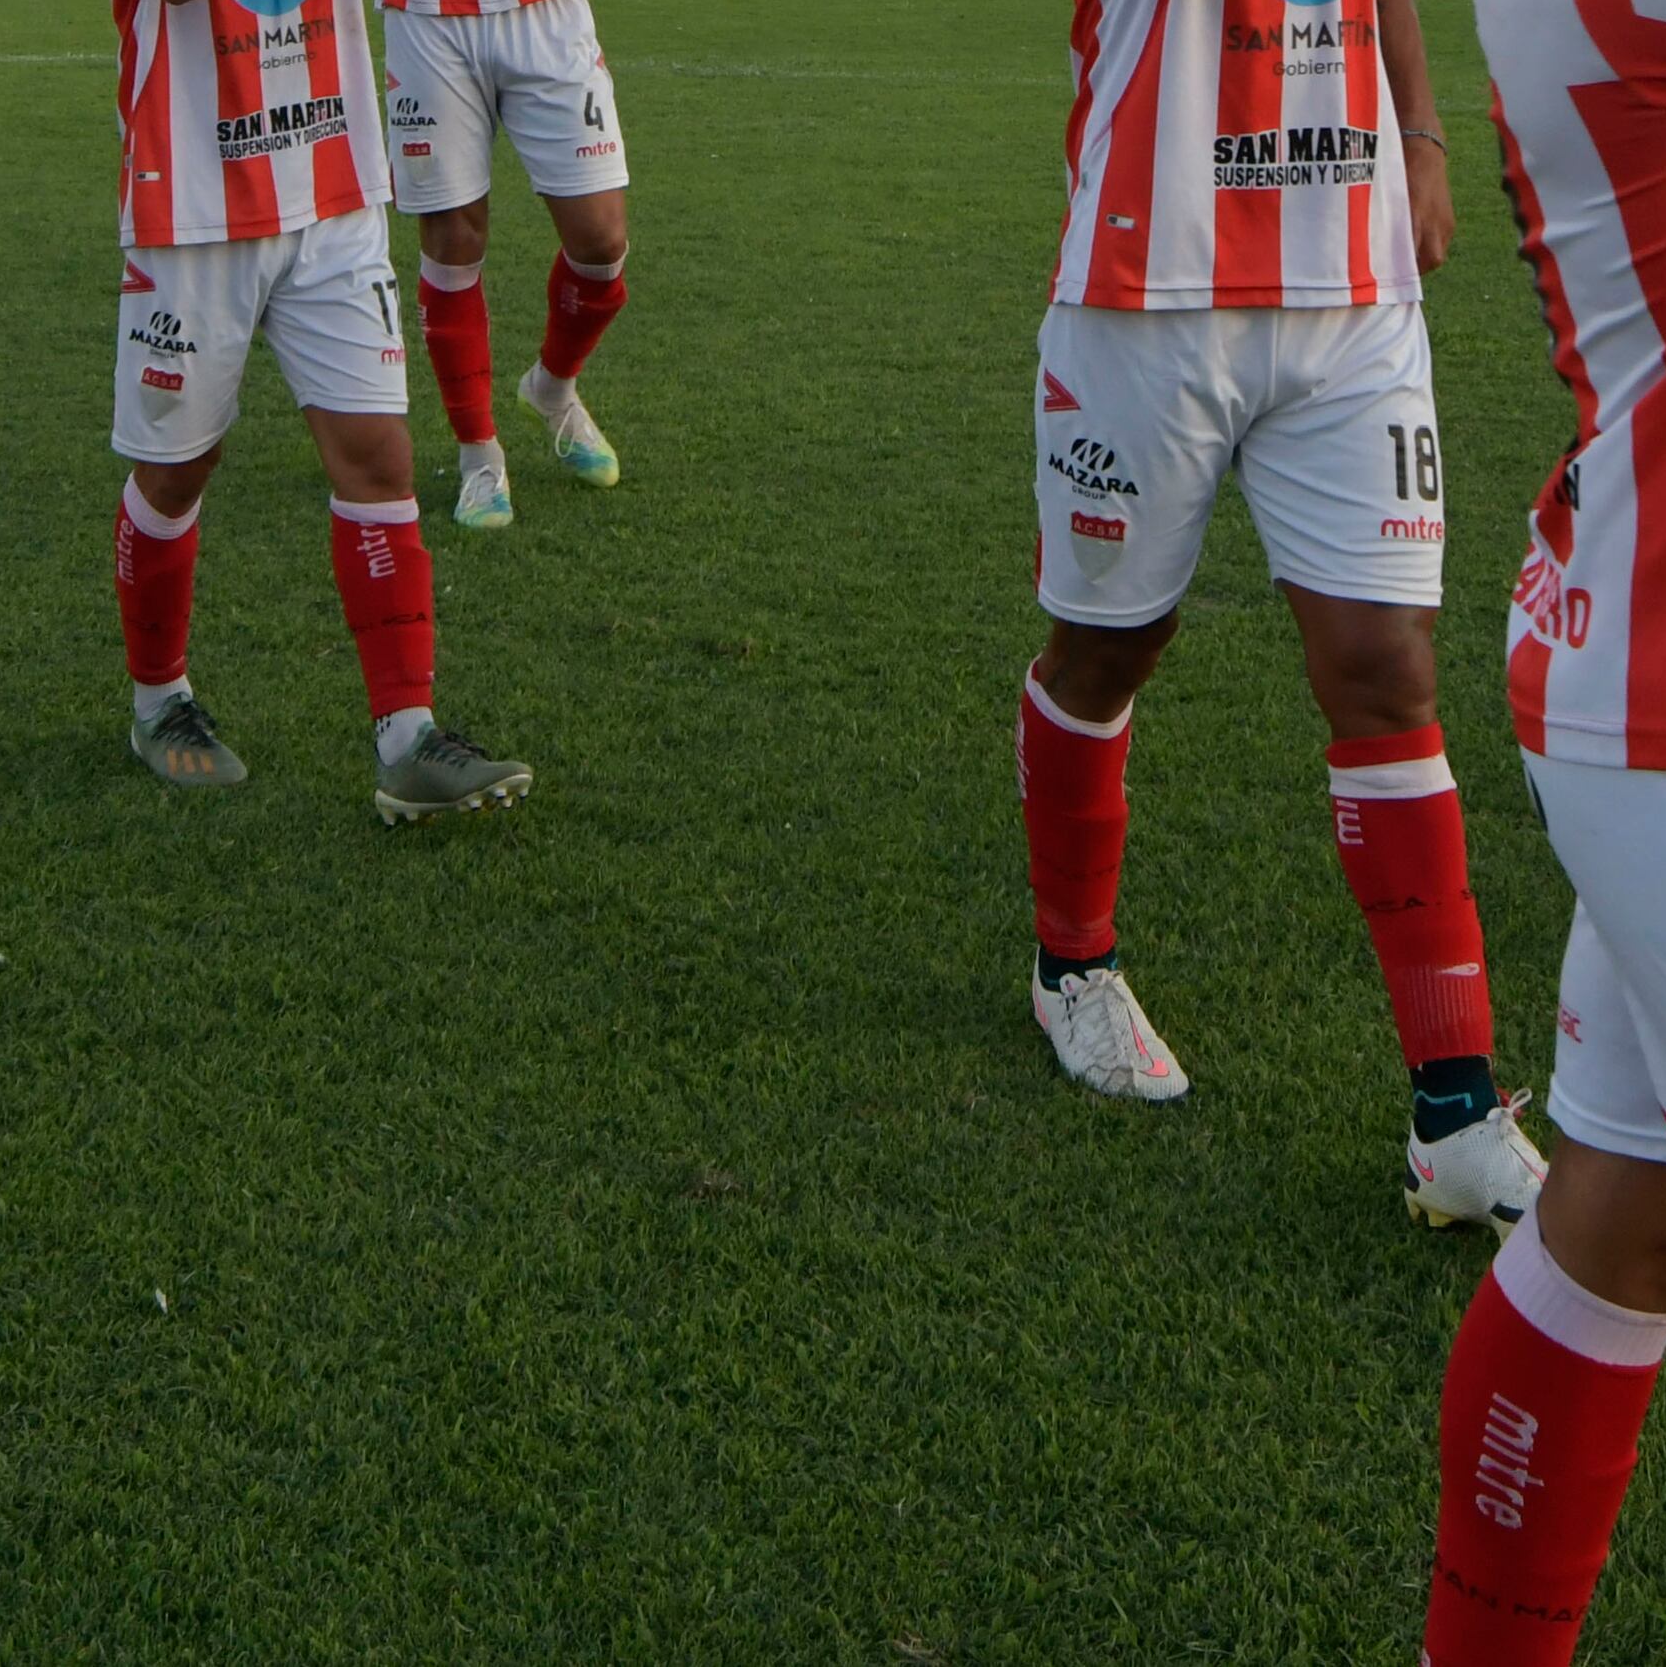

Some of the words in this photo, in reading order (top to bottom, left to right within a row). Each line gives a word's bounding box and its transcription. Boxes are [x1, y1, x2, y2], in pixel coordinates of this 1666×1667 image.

[1225, 22, 1283, 52] SAN
[217, 112, 265, 142] SAN
[269, 97, 345, 136] MARTIN
[584, 91, 604, 132] 4
[219, 135, 291, 159] SUSPENSION
[295, 133, 302, 149] Y
[576, 141, 616, 158] mitre
[1214, 130, 1278, 165] SAN
[1214, 165, 1311, 187] SUSPENSION
[1318, 165, 1327, 184] Y
[129, 328, 197, 354] MAZARA
[1048, 453, 1139, 496] MAZARA
[1387, 424, 1439, 502] 18
[1071, 484, 1107, 501] GROUP
[1381, 515, 1443, 540] mitre
[1475, 1391, 1544, 1531] mitre
